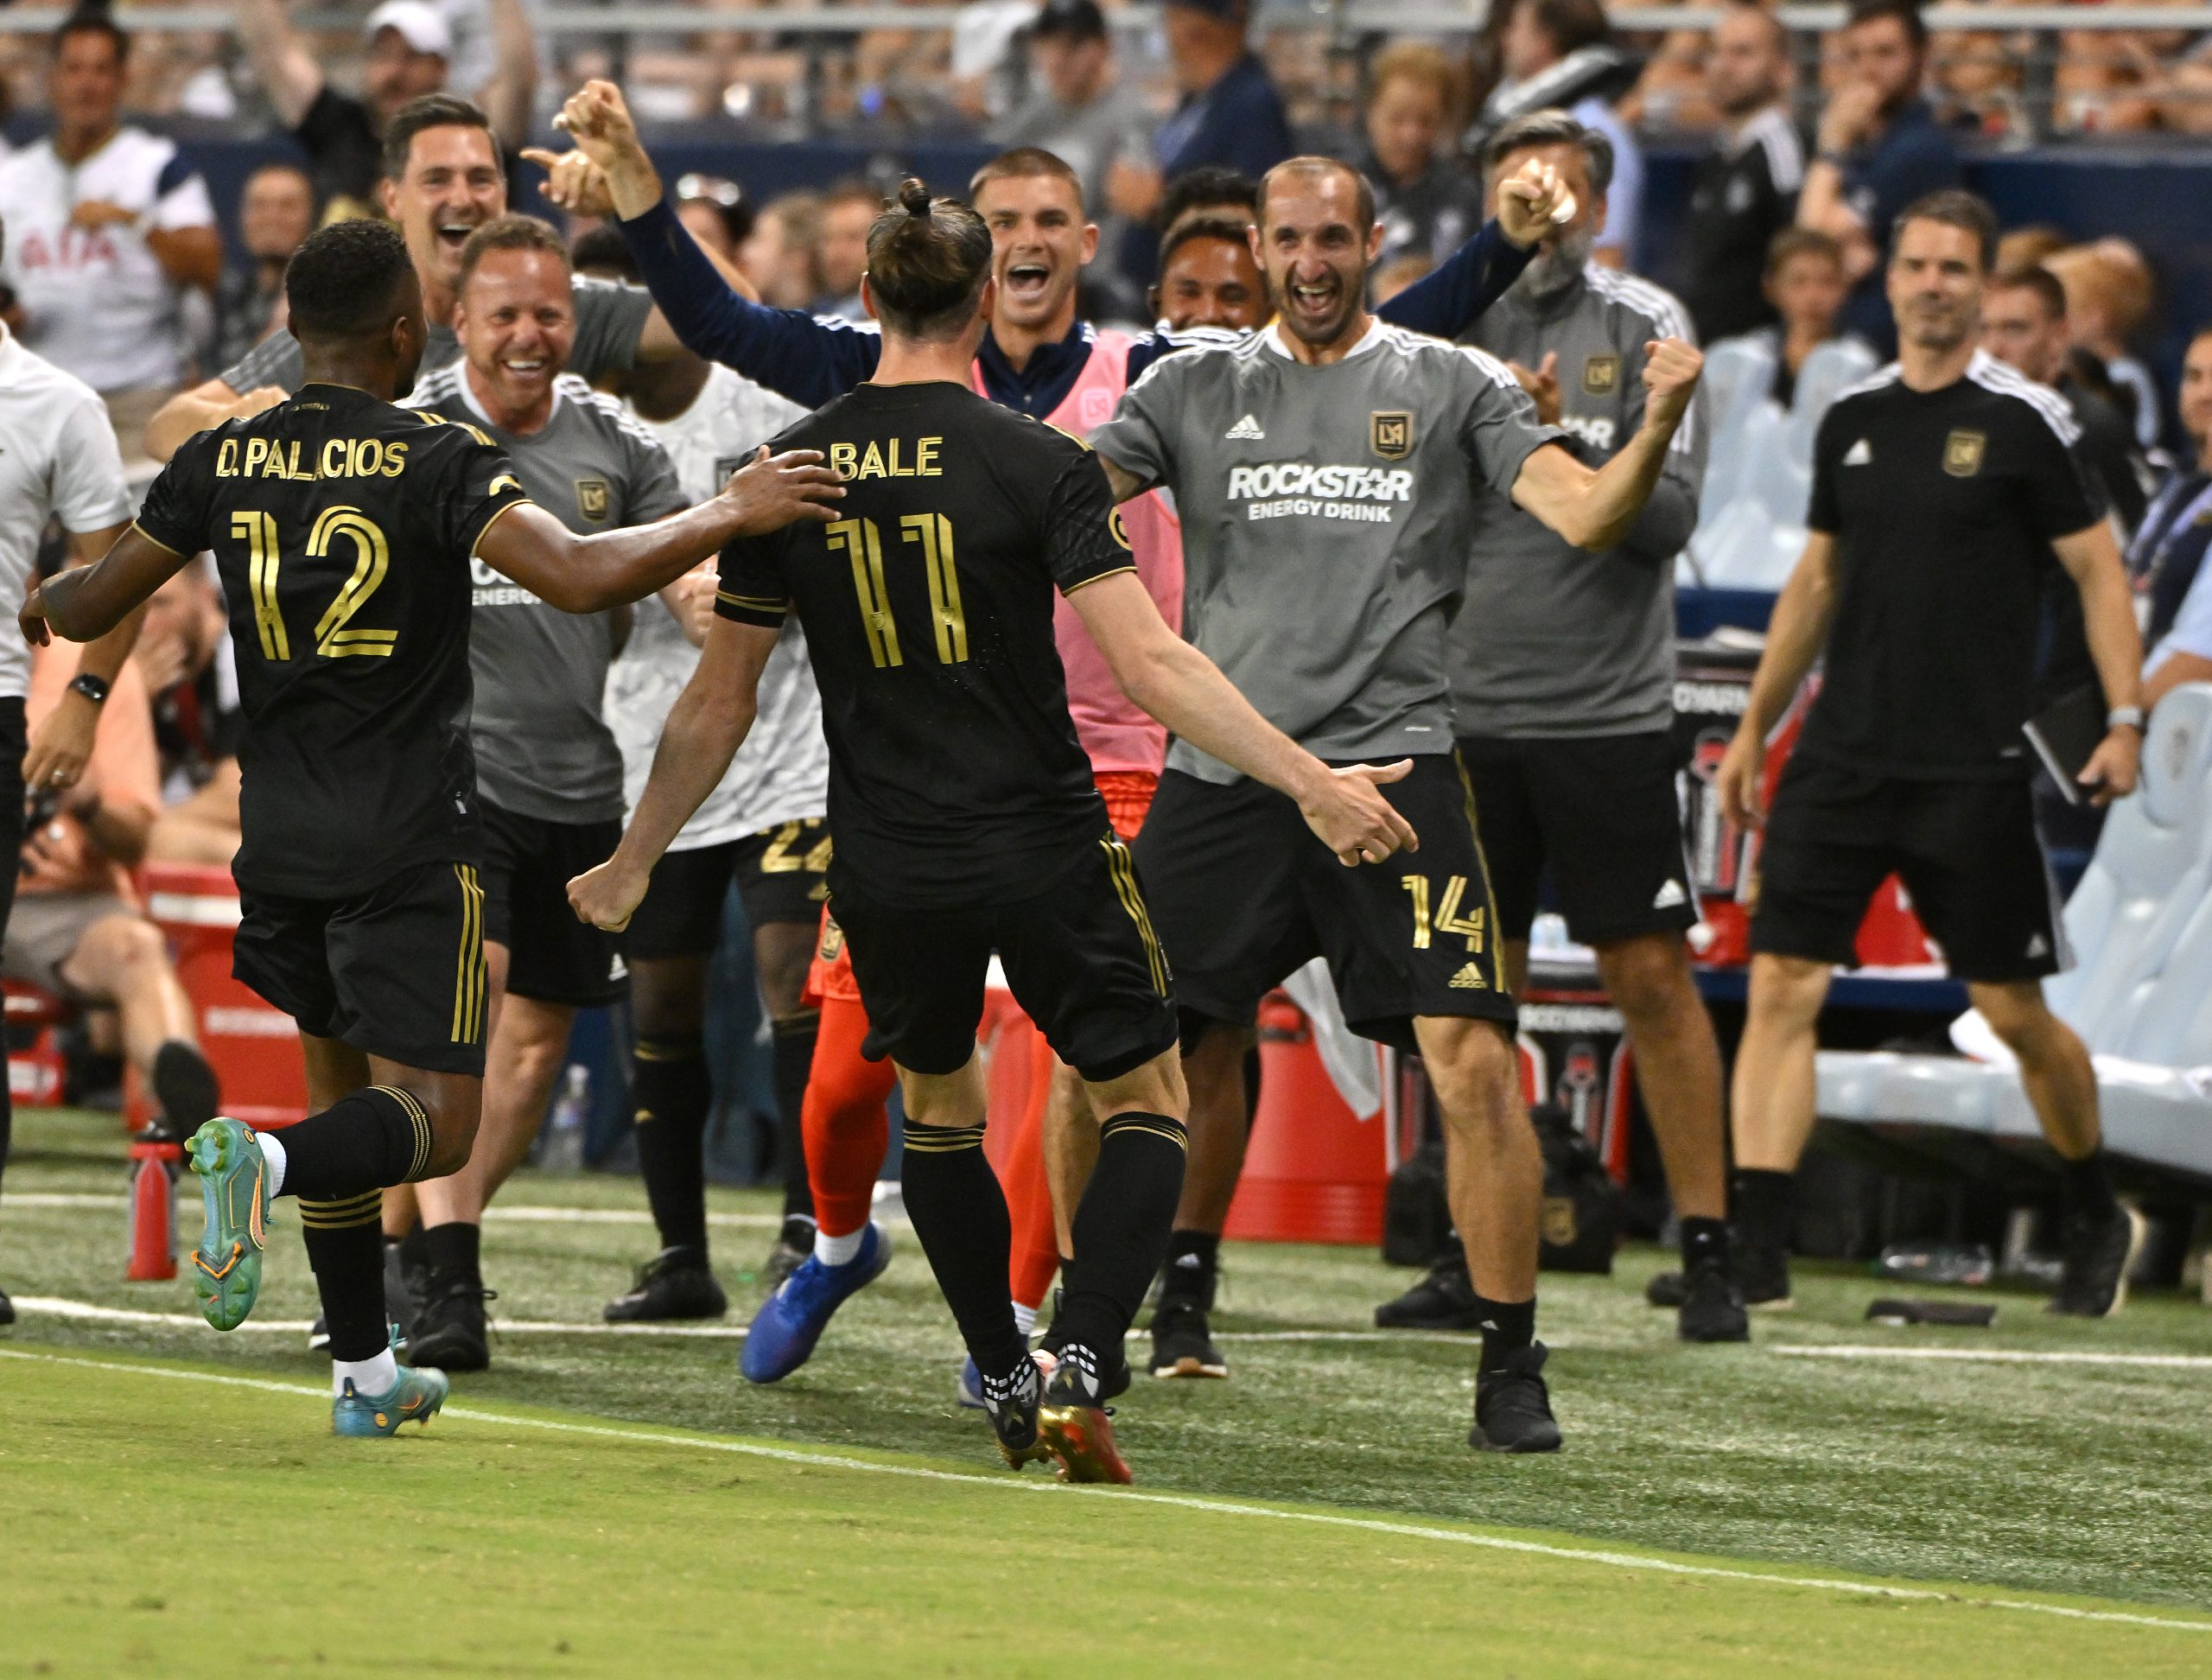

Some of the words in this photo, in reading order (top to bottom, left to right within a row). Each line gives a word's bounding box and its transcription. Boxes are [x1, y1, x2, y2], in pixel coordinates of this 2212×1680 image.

[830, 436, 944, 482] BALE
[1227, 463, 1414, 501] ROCKSTAR
[1248, 498, 1323, 520] ENERGY
[1324, 501, 1391, 522] DRINK
[231, 505, 398, 661] 12
[472, 588, 543, 607] ENERG
[825, 512, 969, 668] 11
[1401, 875, 1485, 953] 14
